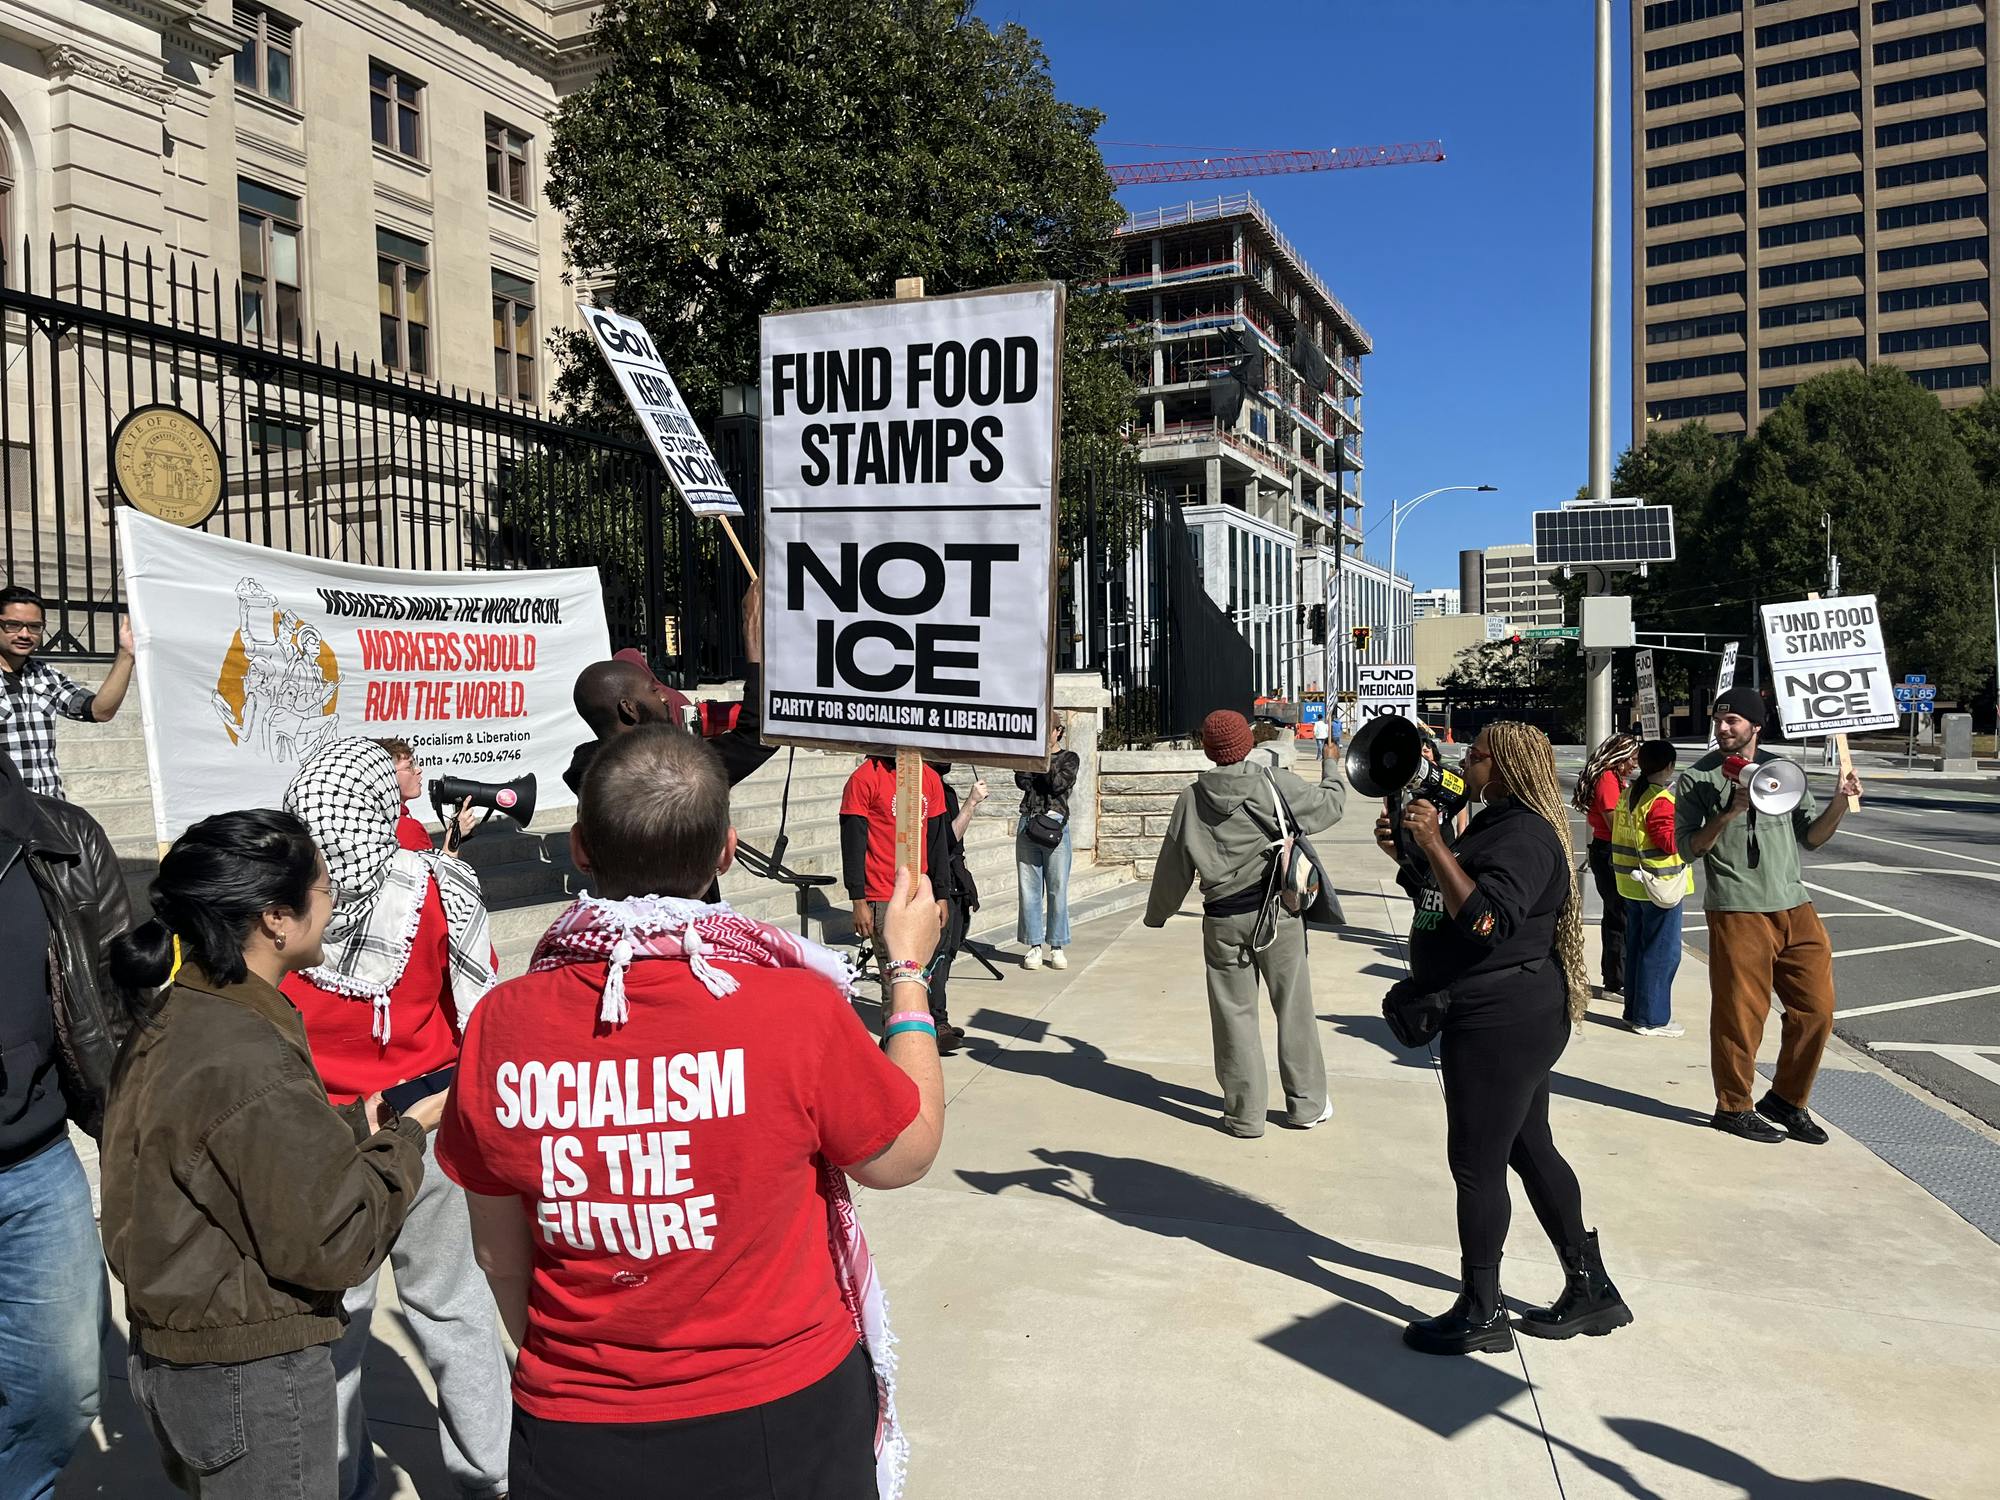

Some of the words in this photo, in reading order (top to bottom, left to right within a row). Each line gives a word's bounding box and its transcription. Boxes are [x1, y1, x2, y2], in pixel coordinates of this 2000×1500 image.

[772, 346, 892, 416] FUND
[906, 335, 1038, 409] FOOD
[652, 414, 680, 435] FUND
[675, 416, 697, 437] FOOD
[122, 425, 144, 472] STATE
[146, 416, 162, 427] OF
[169, 418, 213, 484] GEORGIA
[660, 436, 710, 456] STAMPS
[801, 415, 1004, 487] STAMPS
[159, 508, 185, 518] 1776
[787, 541, 1019, 617] NOT
[317, 588, 407, 620] WORKERS
[404, 597, 453, 622] MAKE
[453, 597, 483, 622] THE
[480, 598, 533, 624] WORLD
[532, 598, 562, 624] RUN.
[1562, 628, 1573, 636] King
[1769, 612, 1820, 634] FUND
[1824, 606, 1874, 629] FOOD
[357, 629, 463, 672] WORKERS
[463, 633, 537, 672] SHOULD
[1785, 629, 1866, 654] STAMPS
[817, 619, 980, 697] ICE
[1360, 669, 1414, 681] FUND
[1785, 667, 1877, 697] NOT
[365, 680, 411, 722] RUN
[415, 680, 454, 721] THE
[456, 681, 528, 719] WORLD.
[1360, 684, 1414, 697] MEDICAID
[1896, 688, 1911, 699] 75
[1918, 688, 1934, 699] 85
[772, 697, 814, 717] PARTY
[817, 700, 843, 720] FOR
[847, 702, 924, 726] SOCIALISM
[928, 708, 940, 727] &
[944, 709, 1033, 734] LIBERATION
[1305, 705, 1323, 713] GATE
[1362, 704, 1411, 717] NOT
[1803, 692, 1871, 719] ICE
[1788, 723, 1806, 732] PARTY
[1807, 722, 1819, 730] FOR
[1820, 719, 1852, 729] SOCIALISM
[1860, 715, 1894, 725] LIBERATION
[413, 732, 464, 747] Socialism
[466, 732, 474, 745] &
[476, 730, 531, 744] Liberation
[452, 749, 522, 765] 470.509.4746
[495, 1048, 745, 1129] SOCIALISM
[541, 1135, 589, 1198] IS
[597, 1130, 694, 1196] THE
[537, 1193, 718, 1261] FUTURE
